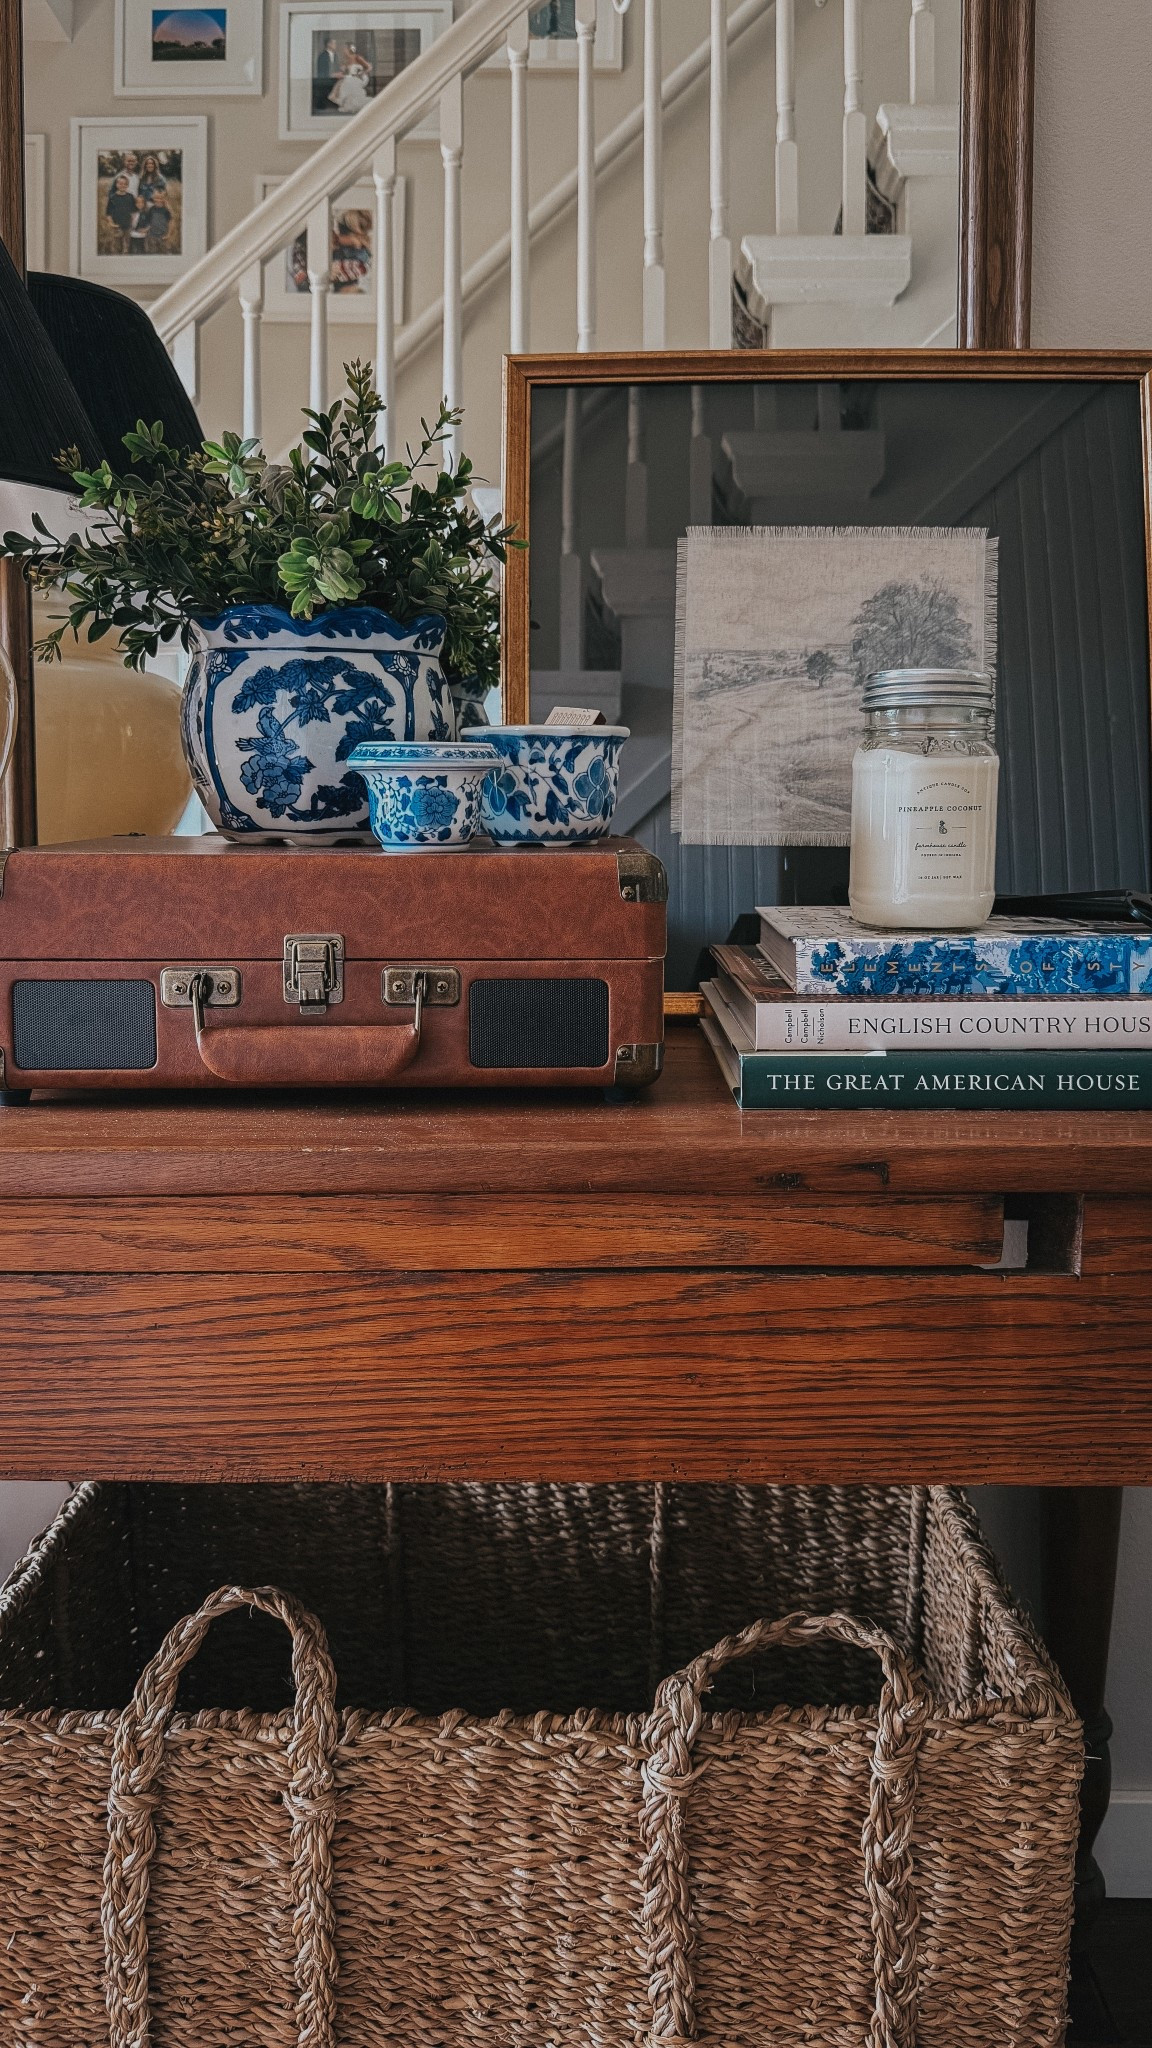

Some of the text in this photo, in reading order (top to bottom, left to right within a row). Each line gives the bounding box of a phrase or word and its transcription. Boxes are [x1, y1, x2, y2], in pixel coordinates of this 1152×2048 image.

[914, 842, 947, 851] farmhouse
[810, 961, 988, 974] ELEMENTS
[1019, 960, 1055, 974] OF
[784, 1009, 796, 1044] Campbell
[800, 1009, 812, 1044] Campbell
[817, 1008, 825, 1045] Nicholson
[848, 1017, 952, 1034] ENGLISH
[959, 1016, 1077, 1034] COUNTRY
[766, 1073, 1140, 1091] THE GREAT AMERICAN HOUSE
